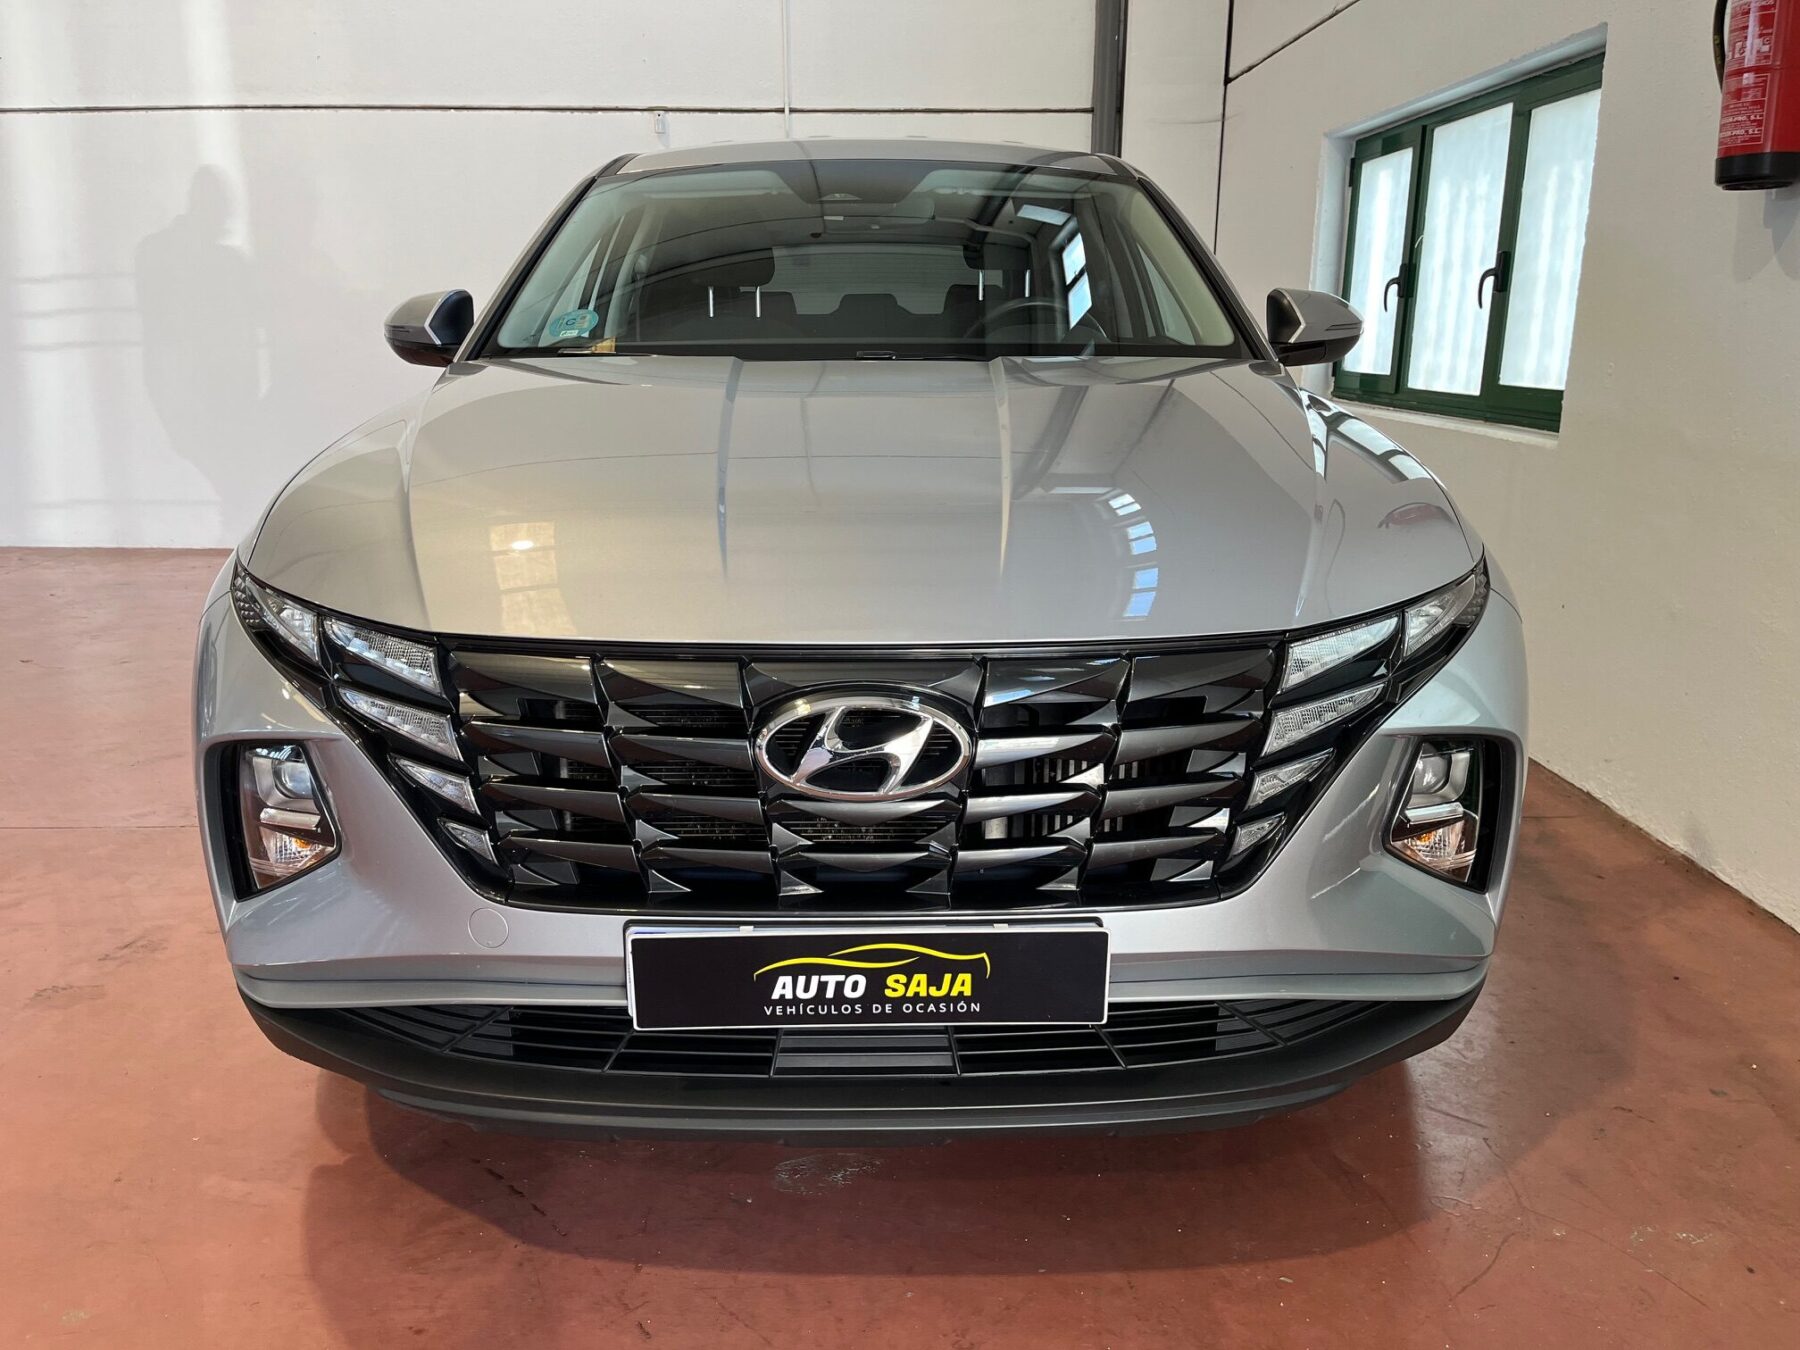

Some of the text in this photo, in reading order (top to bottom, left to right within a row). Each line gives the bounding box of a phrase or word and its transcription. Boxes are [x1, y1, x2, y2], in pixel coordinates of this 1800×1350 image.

[771, 973, 972, 1000] AUTO SAJA
[763, 1000, 980, 1016] VEHÍCULOS DE OCASIÓN
